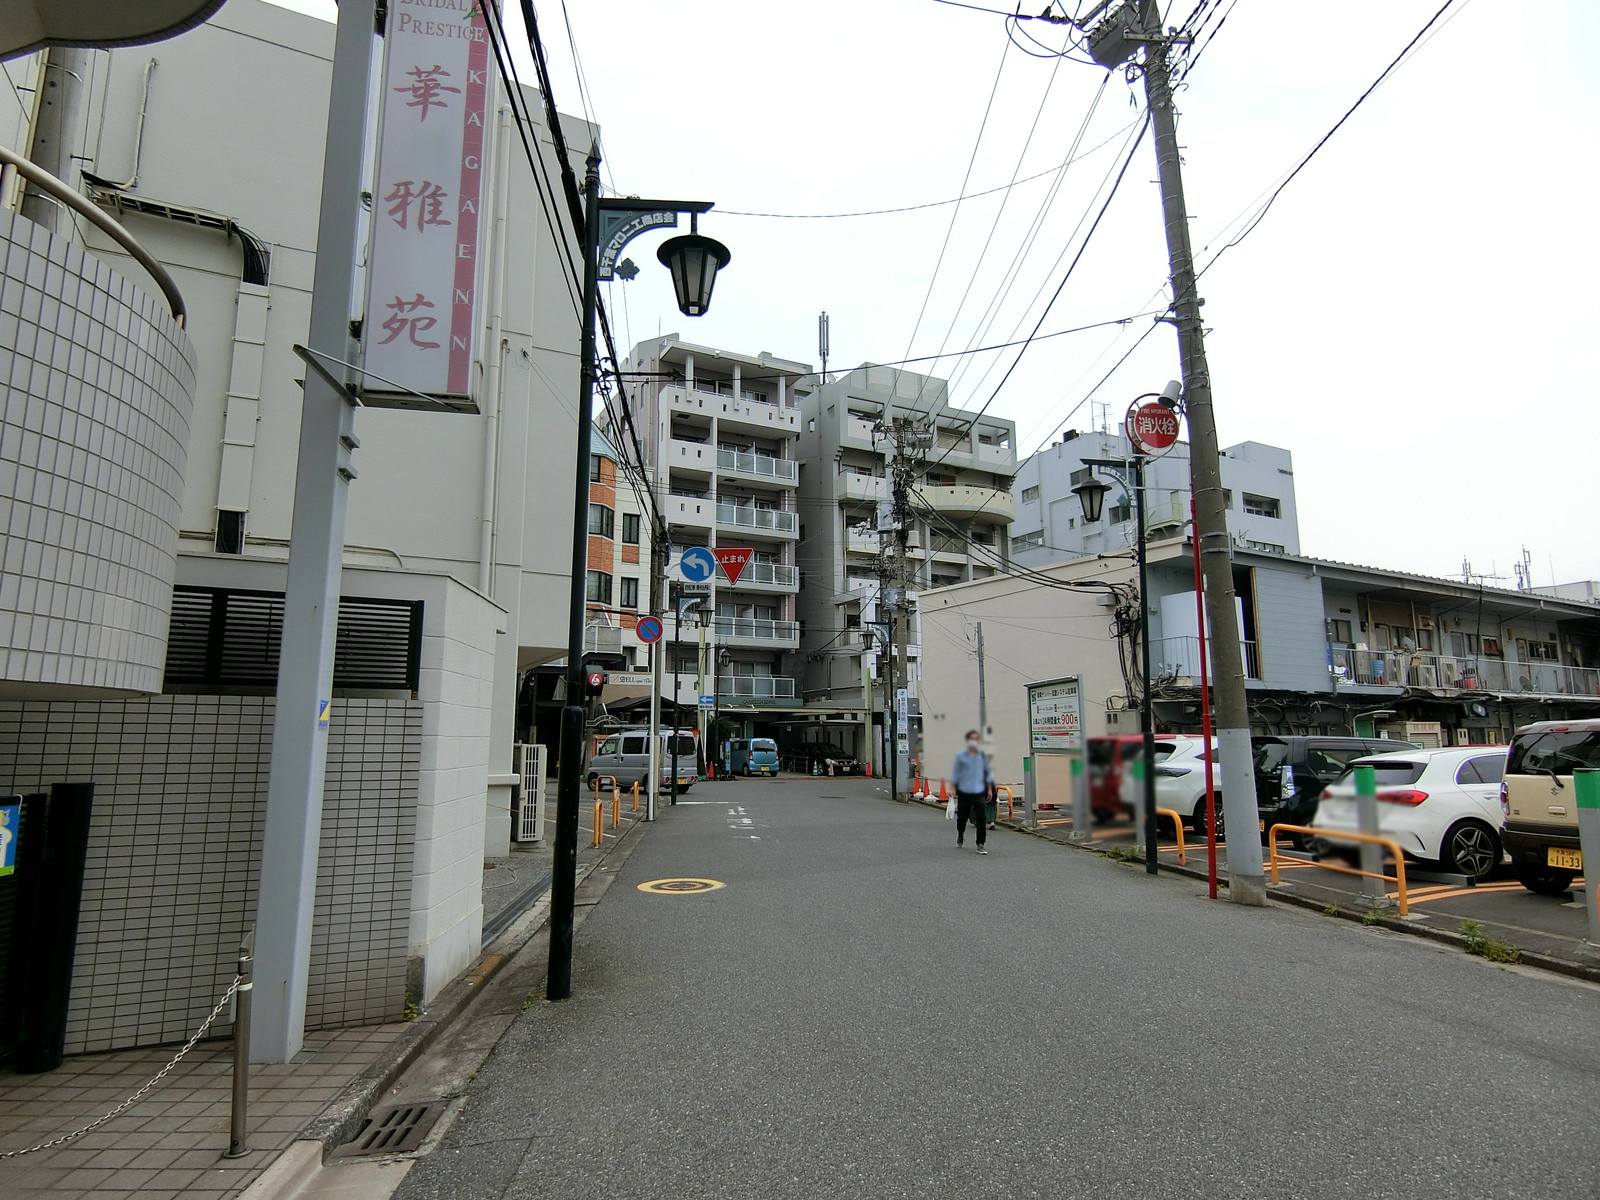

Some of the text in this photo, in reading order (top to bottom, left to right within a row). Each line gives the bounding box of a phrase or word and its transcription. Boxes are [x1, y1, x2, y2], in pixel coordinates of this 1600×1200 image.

[400, 0, 468, 12] IDAL
[398, 13, 484, 42] PRESTIGE
[599, 212, 674, 277] 西千葉マロニエ商店会
[1138, 416, 1176, 435] 消火栓
[721, 554, 745, 564] 止まれ
[1556, 856, 1580, 868] 11-33
